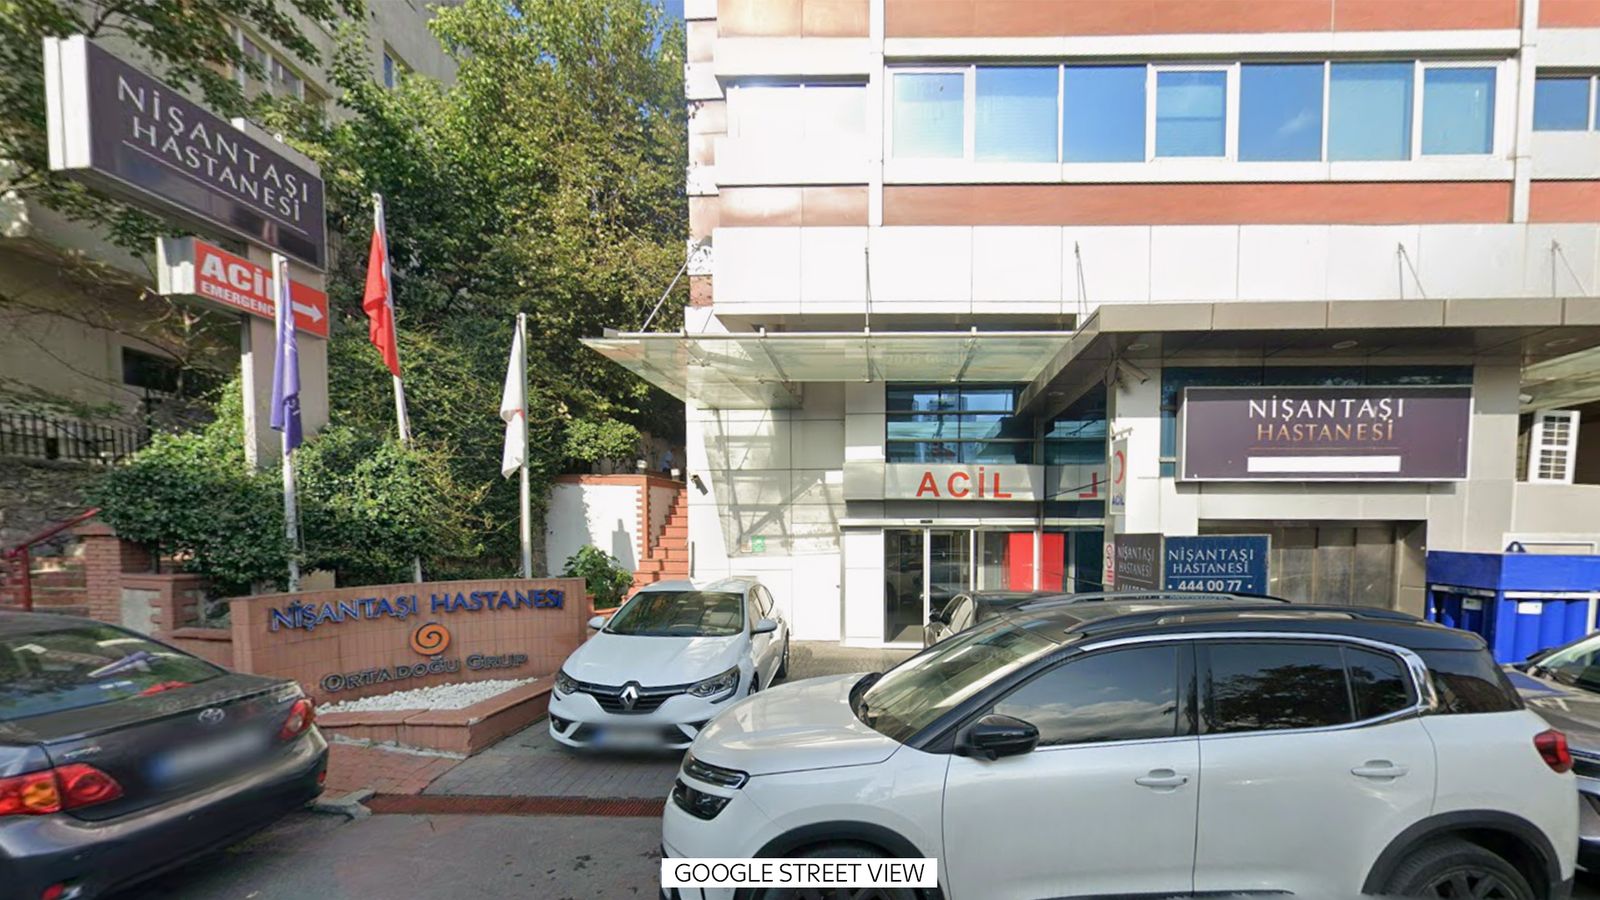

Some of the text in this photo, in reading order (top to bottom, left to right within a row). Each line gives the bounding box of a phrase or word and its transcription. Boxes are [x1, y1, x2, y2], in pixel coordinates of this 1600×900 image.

[117, 75, 308, 204] NİŞANTAŞI
[132, 116, 300, 221] HASTANESİ
[201, 280, 276, 316] EMERGENC
[1249, 395, 1404, 421] NİŞANTAŞI
[1257, 419, 1393, 441] HASTANESİ
[916, 467, 1012, 498] ACİL
[1168, 547, 1253, 563] NİŞANTAŞI
[1173, 560, 1249, 574] HASTANESİ
[1178, 580, 1242, 592] 444 00 77
[270, 596, 417, 631] NİŞANTAŞI
